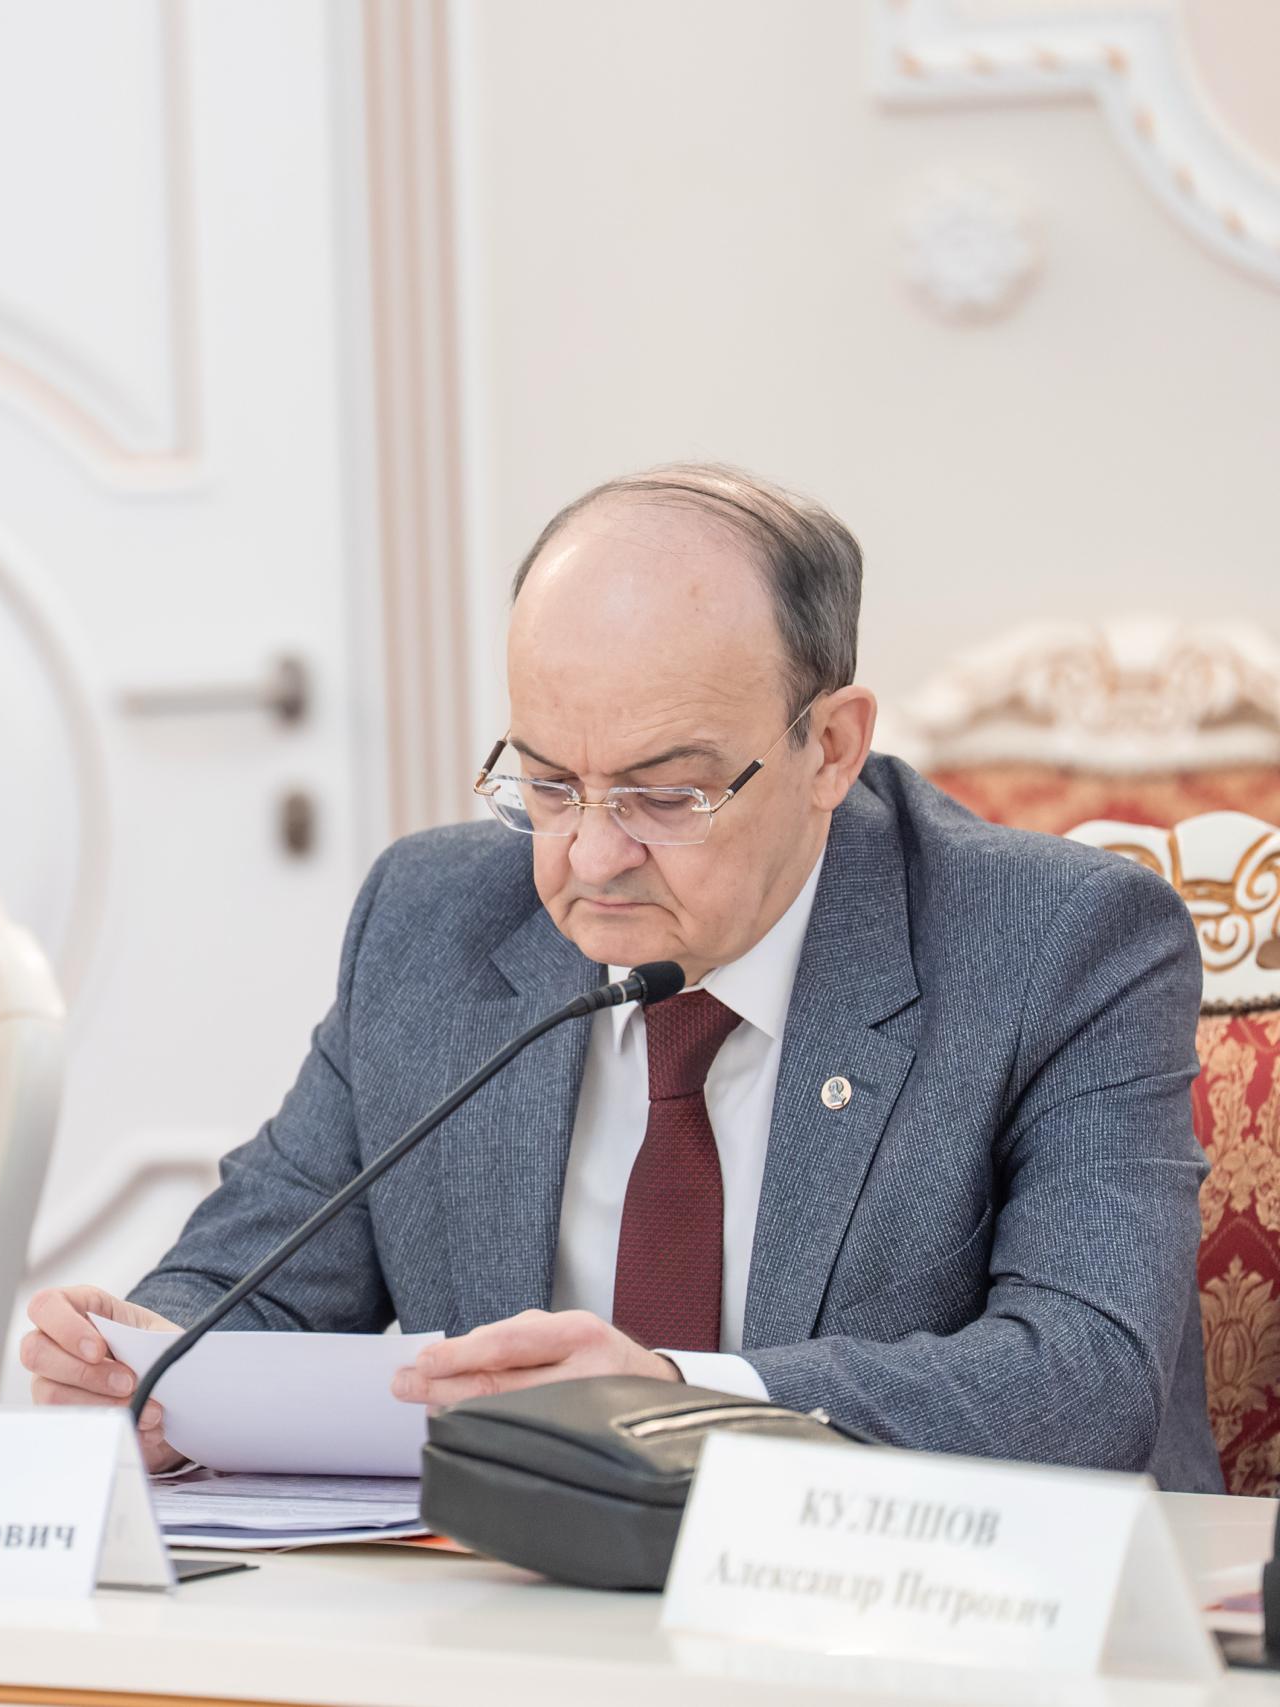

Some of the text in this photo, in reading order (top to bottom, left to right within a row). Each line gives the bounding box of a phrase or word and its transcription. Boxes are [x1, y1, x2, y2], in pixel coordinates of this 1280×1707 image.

[798, 1486, 1002, 1548] КУЛЕШОВ
[706, 1550, 1061, 1630] Александр Петрович
